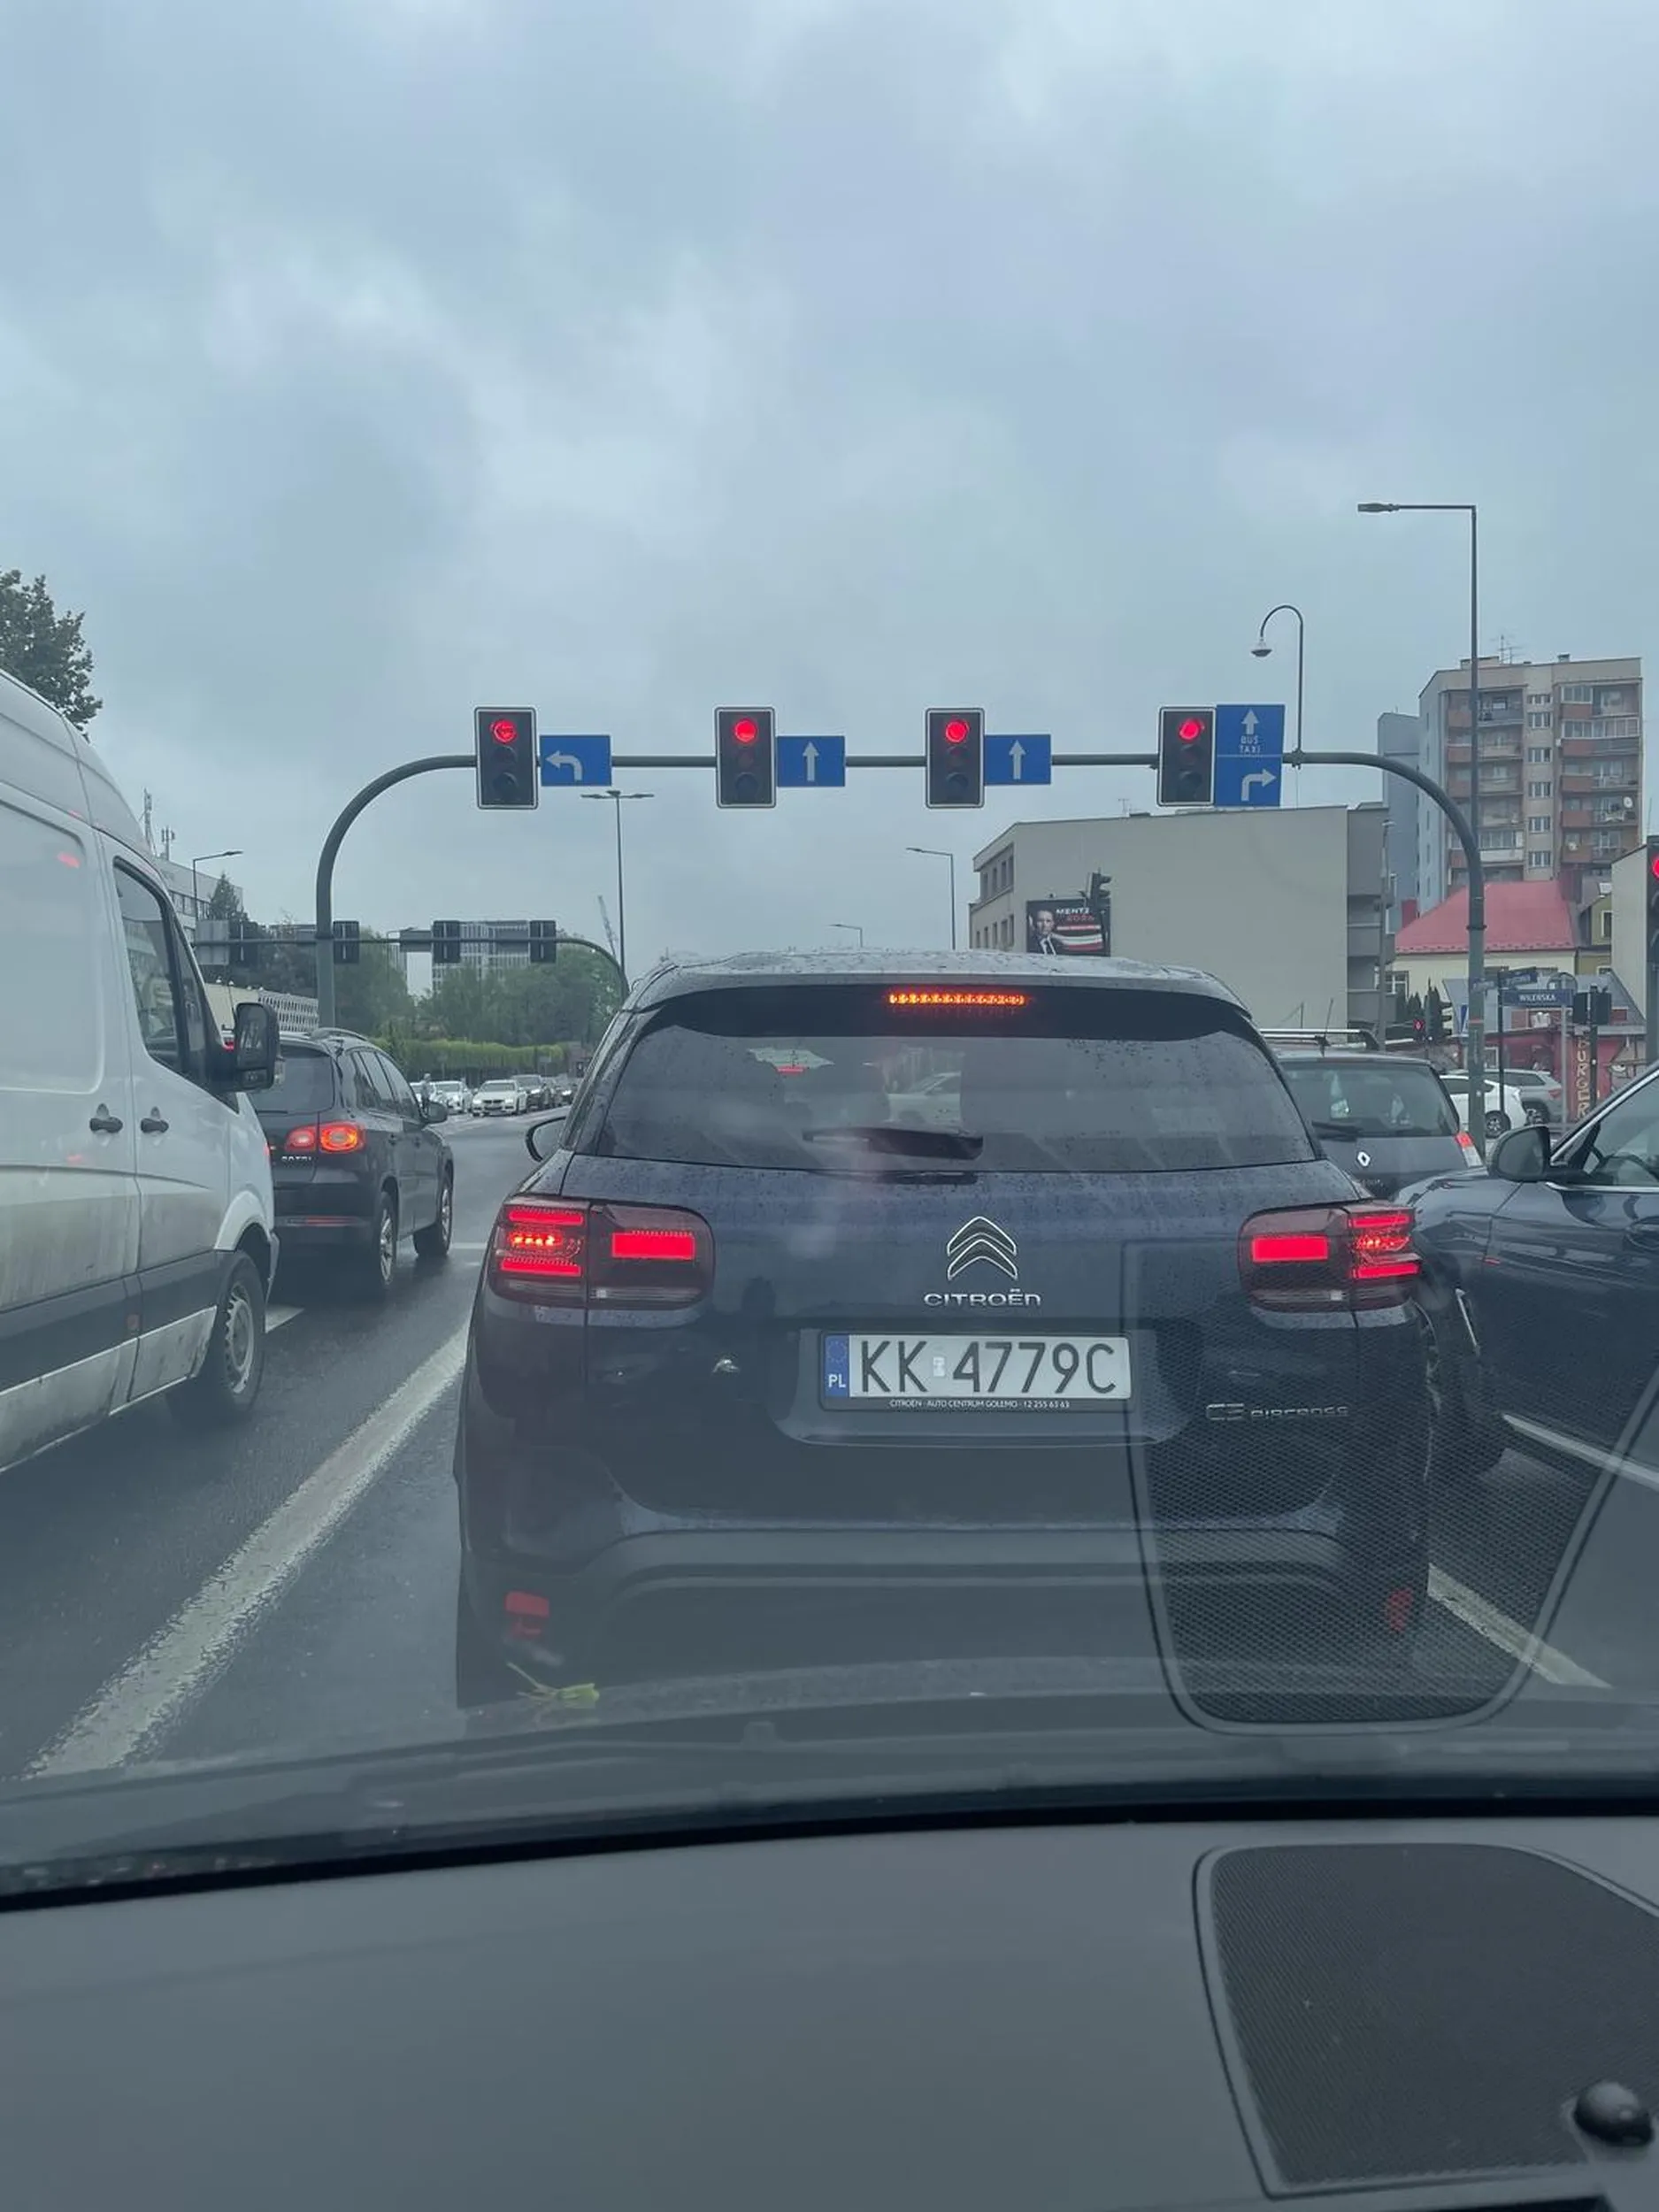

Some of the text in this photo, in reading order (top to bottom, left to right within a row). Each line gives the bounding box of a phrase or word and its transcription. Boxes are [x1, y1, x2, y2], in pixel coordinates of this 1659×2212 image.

[1240, 735, 1258, 744] BUS
[1239, 744, 1261, 756] TAXI
[1576, 1036, 1591, 1120] BURGER
[923, 1288, 1041, 1307] CITROËN
[862, 1340, 1116, 1394] KK 4779C
[828, 1374, 846, 1388] PL
